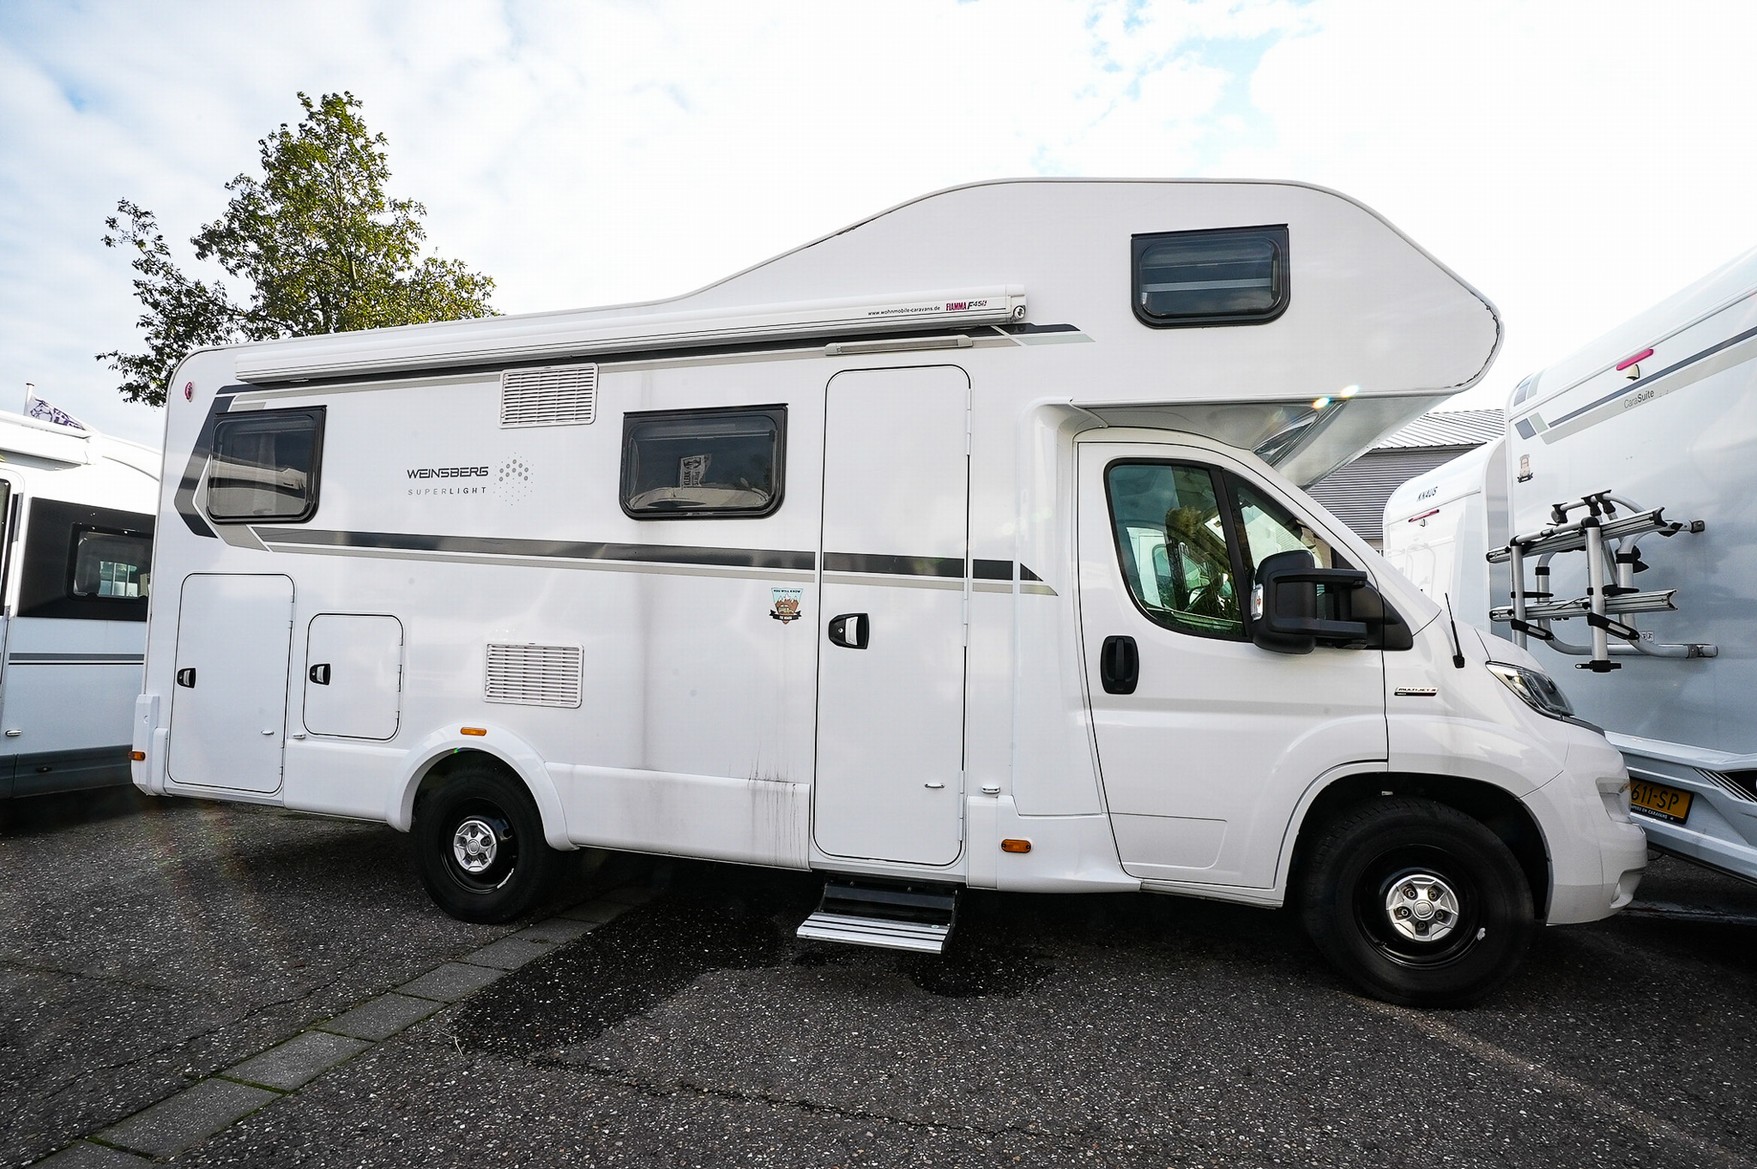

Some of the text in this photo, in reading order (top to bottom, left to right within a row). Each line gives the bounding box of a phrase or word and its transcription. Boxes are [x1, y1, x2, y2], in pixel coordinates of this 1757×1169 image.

[945, 302, 966, 311] FIAMMA
[1623, 390, 1655, 409] CaraSuite
[407, 466, 489, 479] WEINSBERG
[408, 486, 487, 496] SUPERLIGHT
